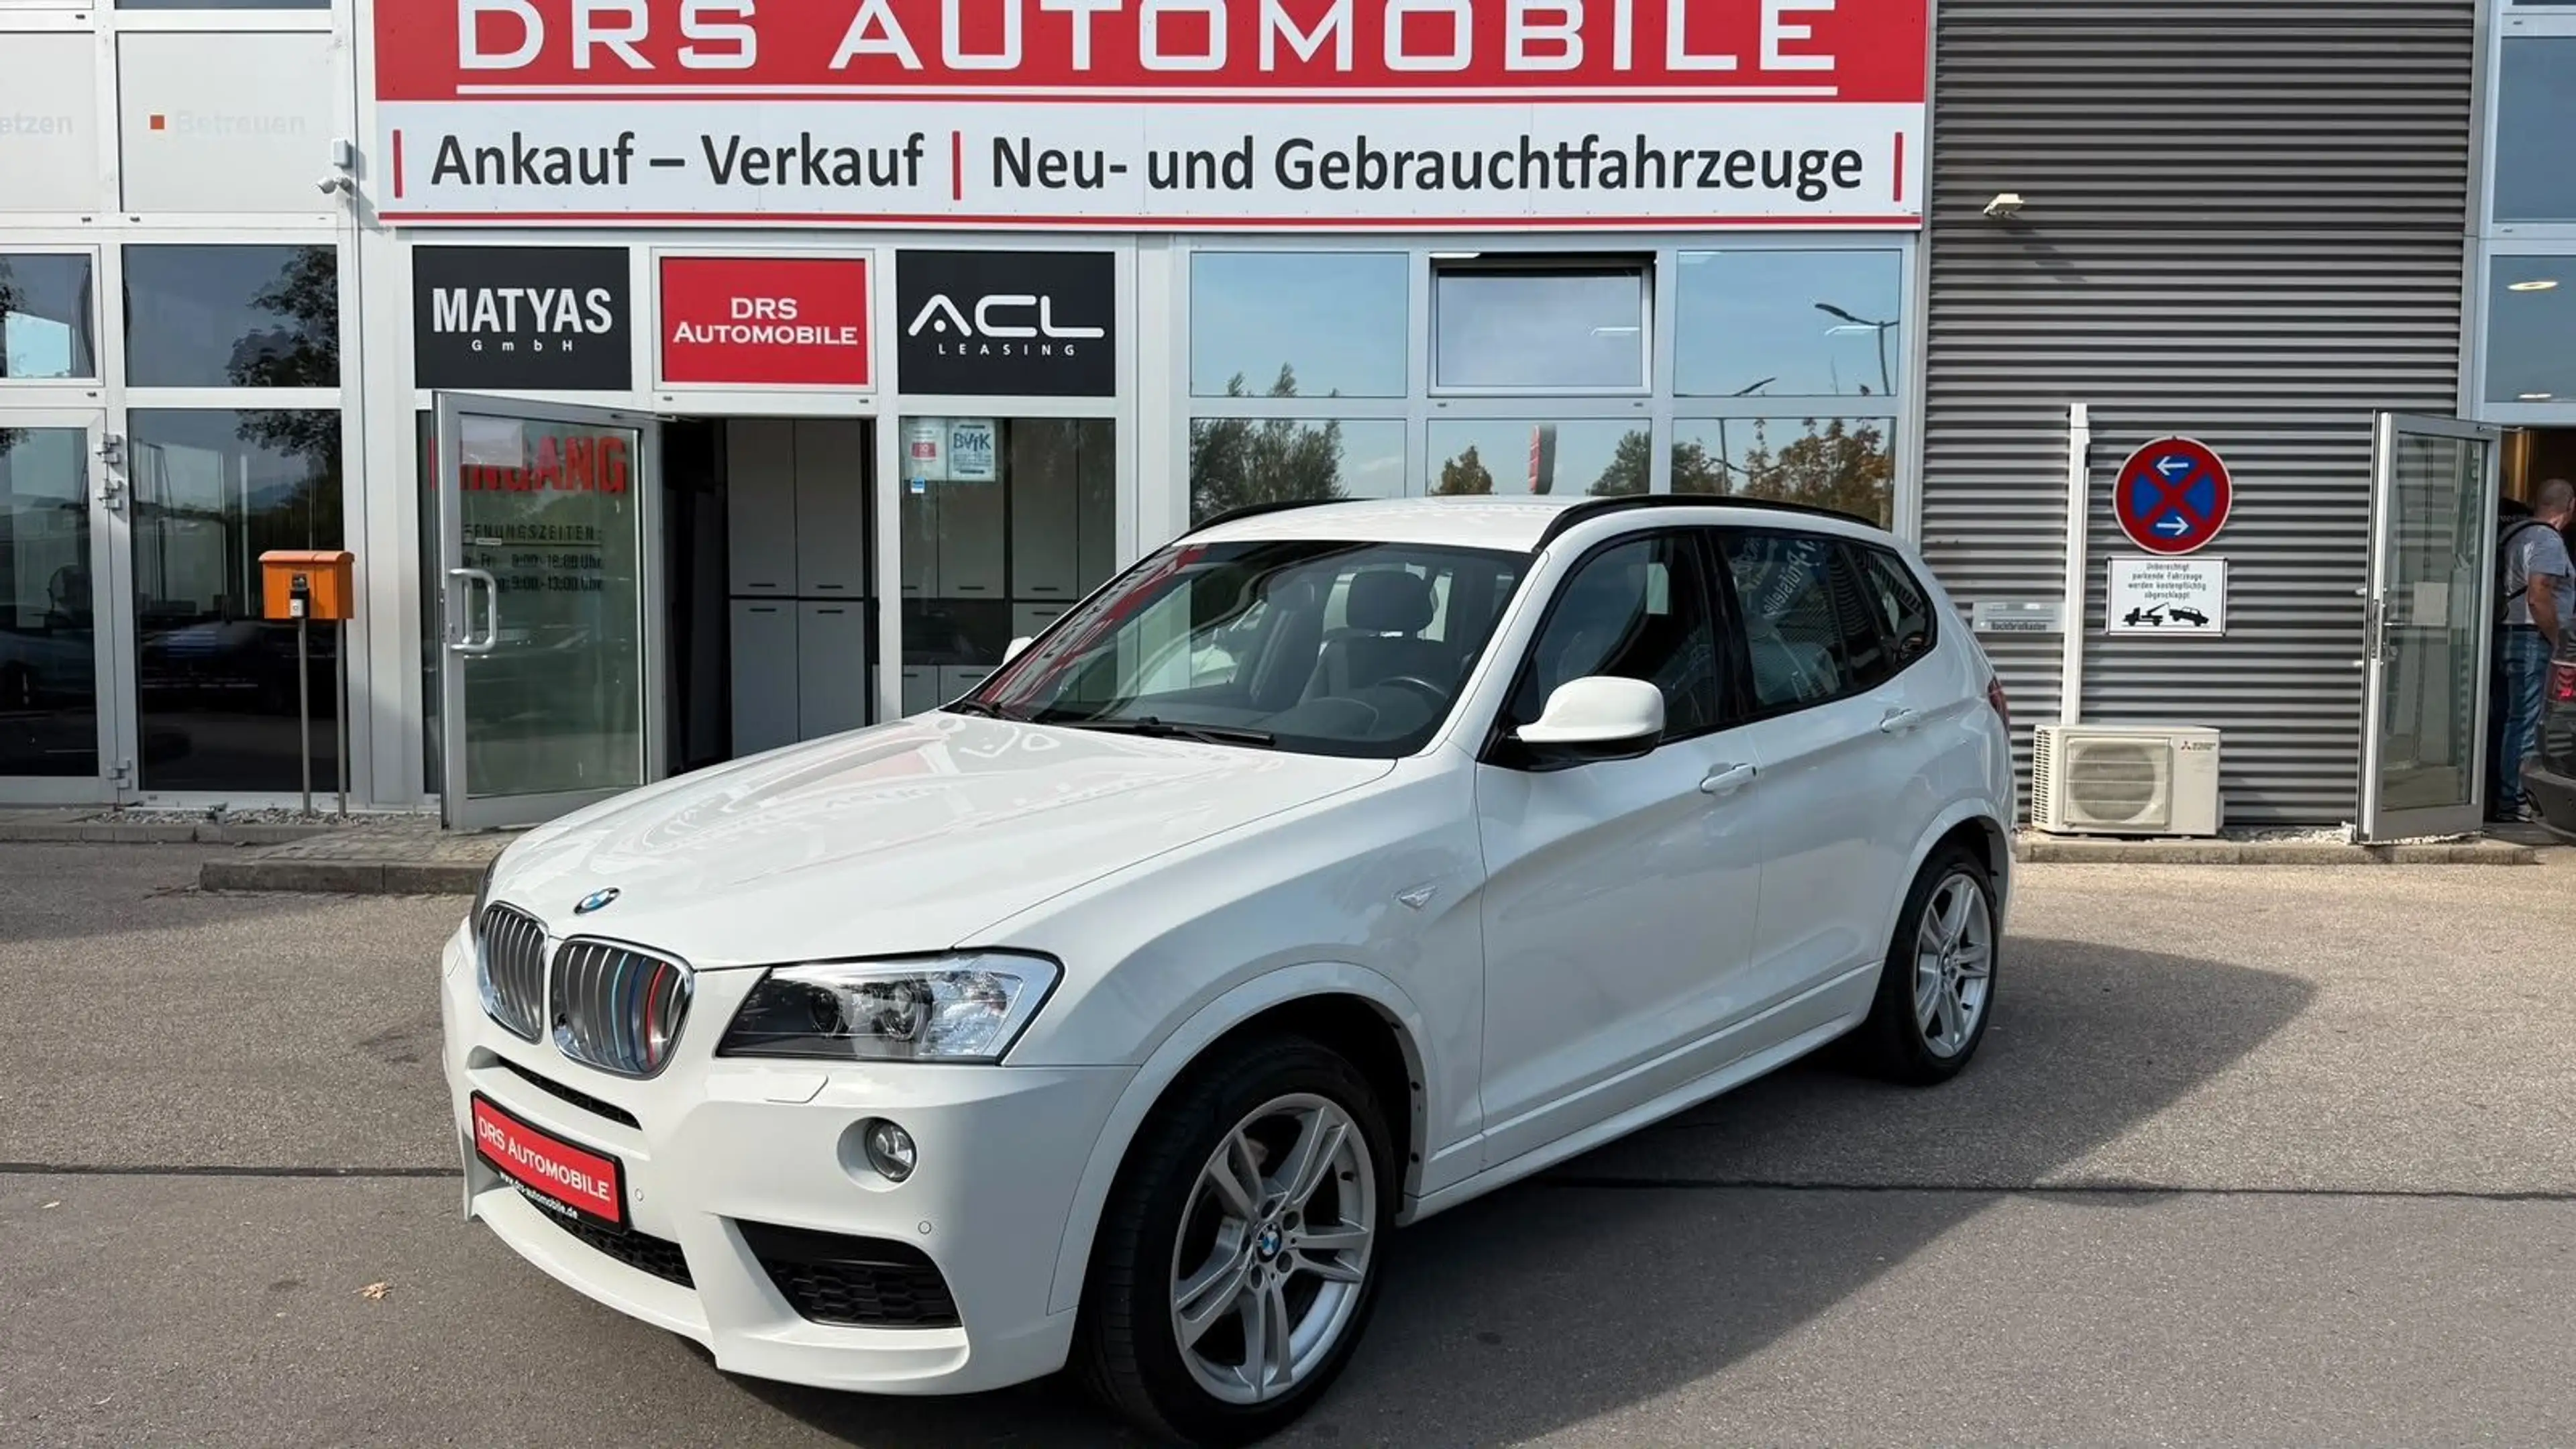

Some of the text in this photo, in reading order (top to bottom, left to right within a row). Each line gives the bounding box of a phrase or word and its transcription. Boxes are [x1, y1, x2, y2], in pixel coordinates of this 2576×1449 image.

[458, 0, 1835, 71] DRS AUTOMOBILE
[431, 132, 634, 186] Ankauf
[701, 133, 924, 187] Verkauf
[991, 136, 1127, 189] Neu-
[1148, 135, 1254, 190] und
[1275, 134, 1862, 203] Gebrauchtfahrzeuge
[432, 287, 613, 333] MATYAS
[731, 297, 798, 321] DRS
[908, 294, 1105, 338] ACL
[938, 343, 1075, 356] LEASING
[478, 1117, 611, 1201] DRS AUTOMOBILE
